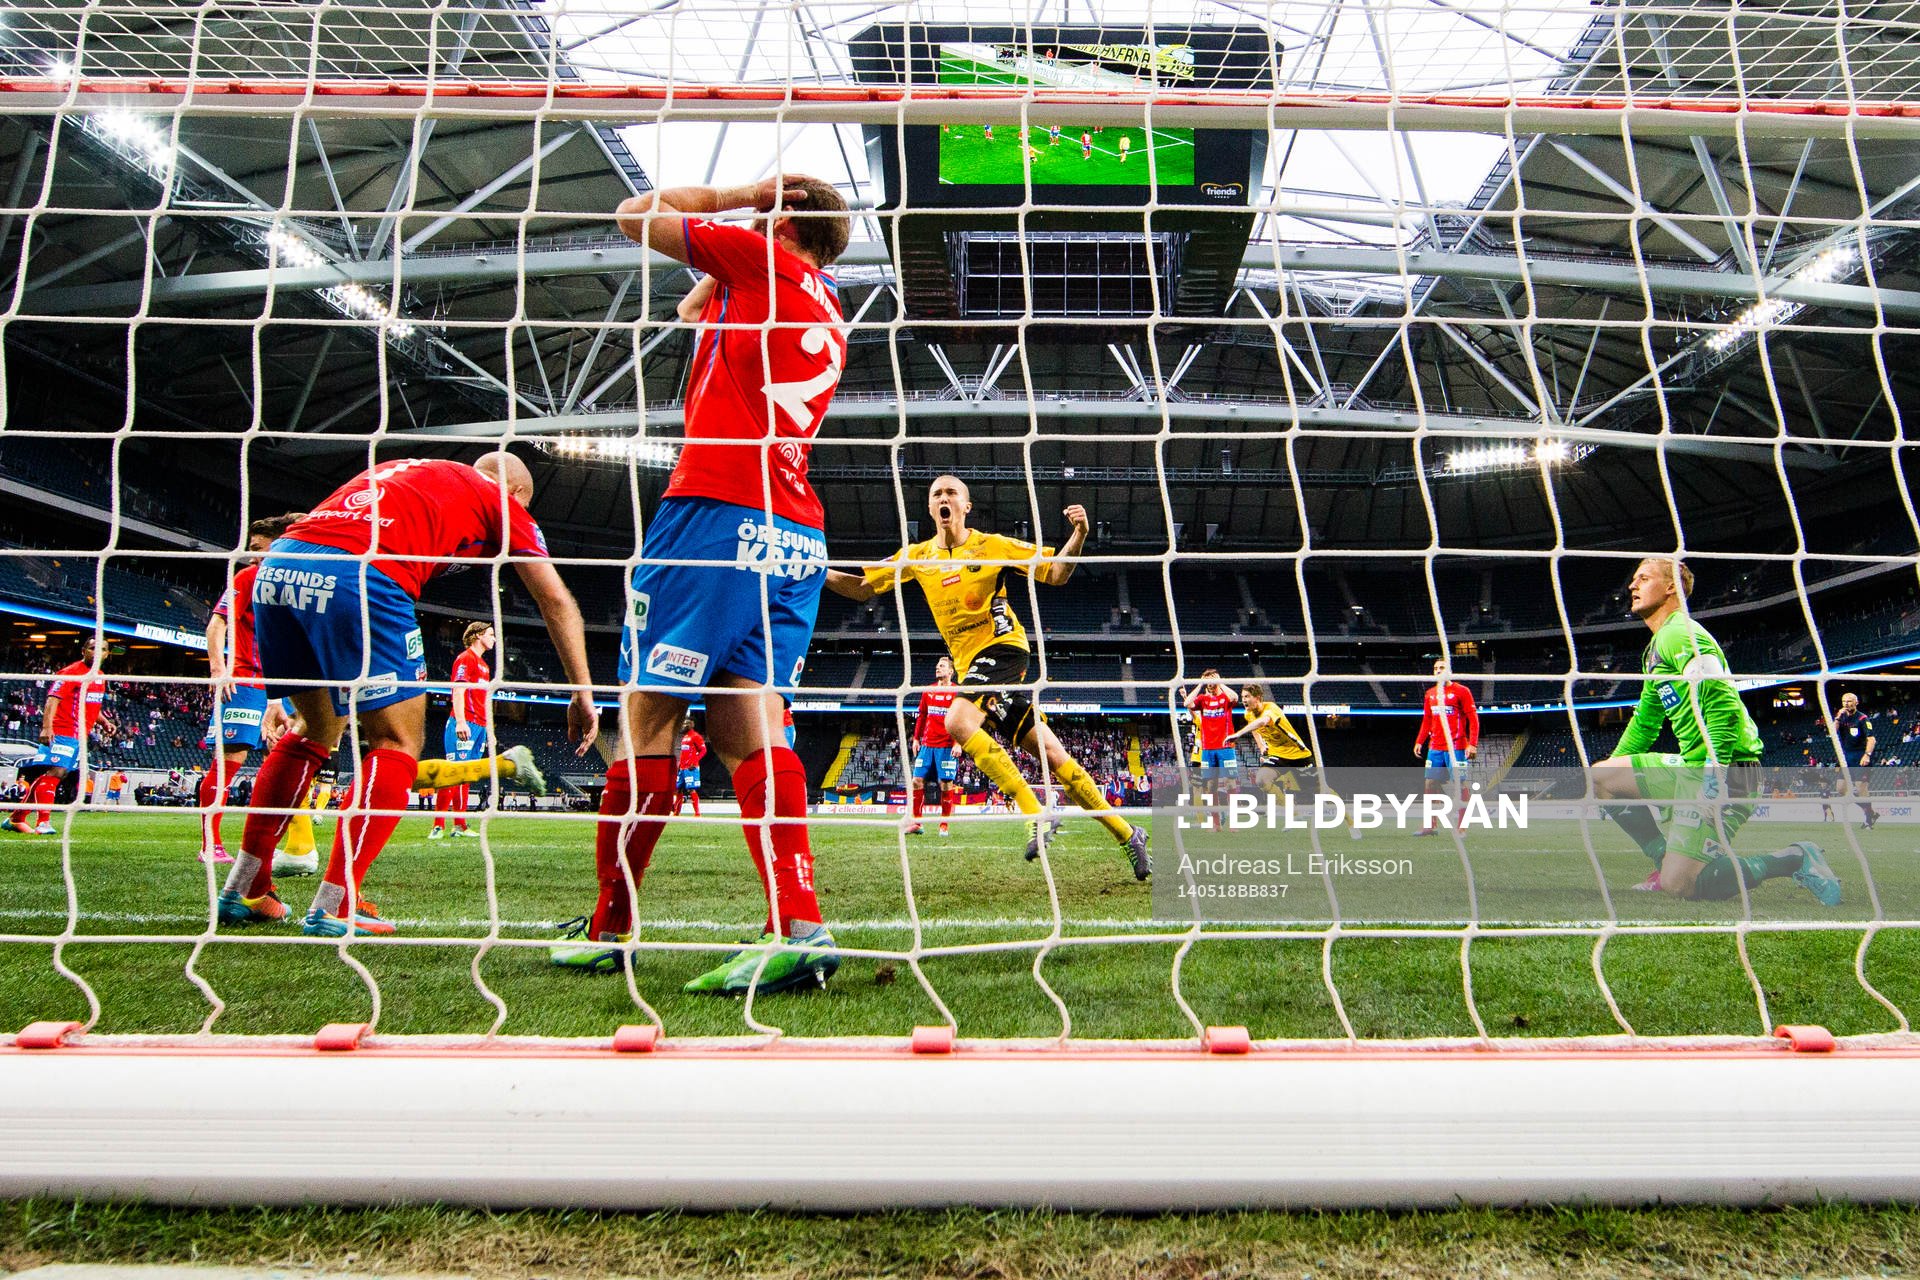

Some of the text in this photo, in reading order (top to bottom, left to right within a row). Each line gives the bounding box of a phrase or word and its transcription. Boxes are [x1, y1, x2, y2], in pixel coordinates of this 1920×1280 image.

[1207, 187, 1236, 195] friends
[363, 513, 394, 527] sd
[737, 518, 828, 558] ÖRESUND
[735, 541, 828, 581] KRAF
[256, 566, 337, 590] RESUNDS
[134, 623, 208, 650] NATIONALSPORTE
[666, 651, 699, 669] INTER
[664, 664, 696, 678] SPORT
[364, 686, 391, 697] SPORT
[1876, 807, 1912, 816] TERSPORT
